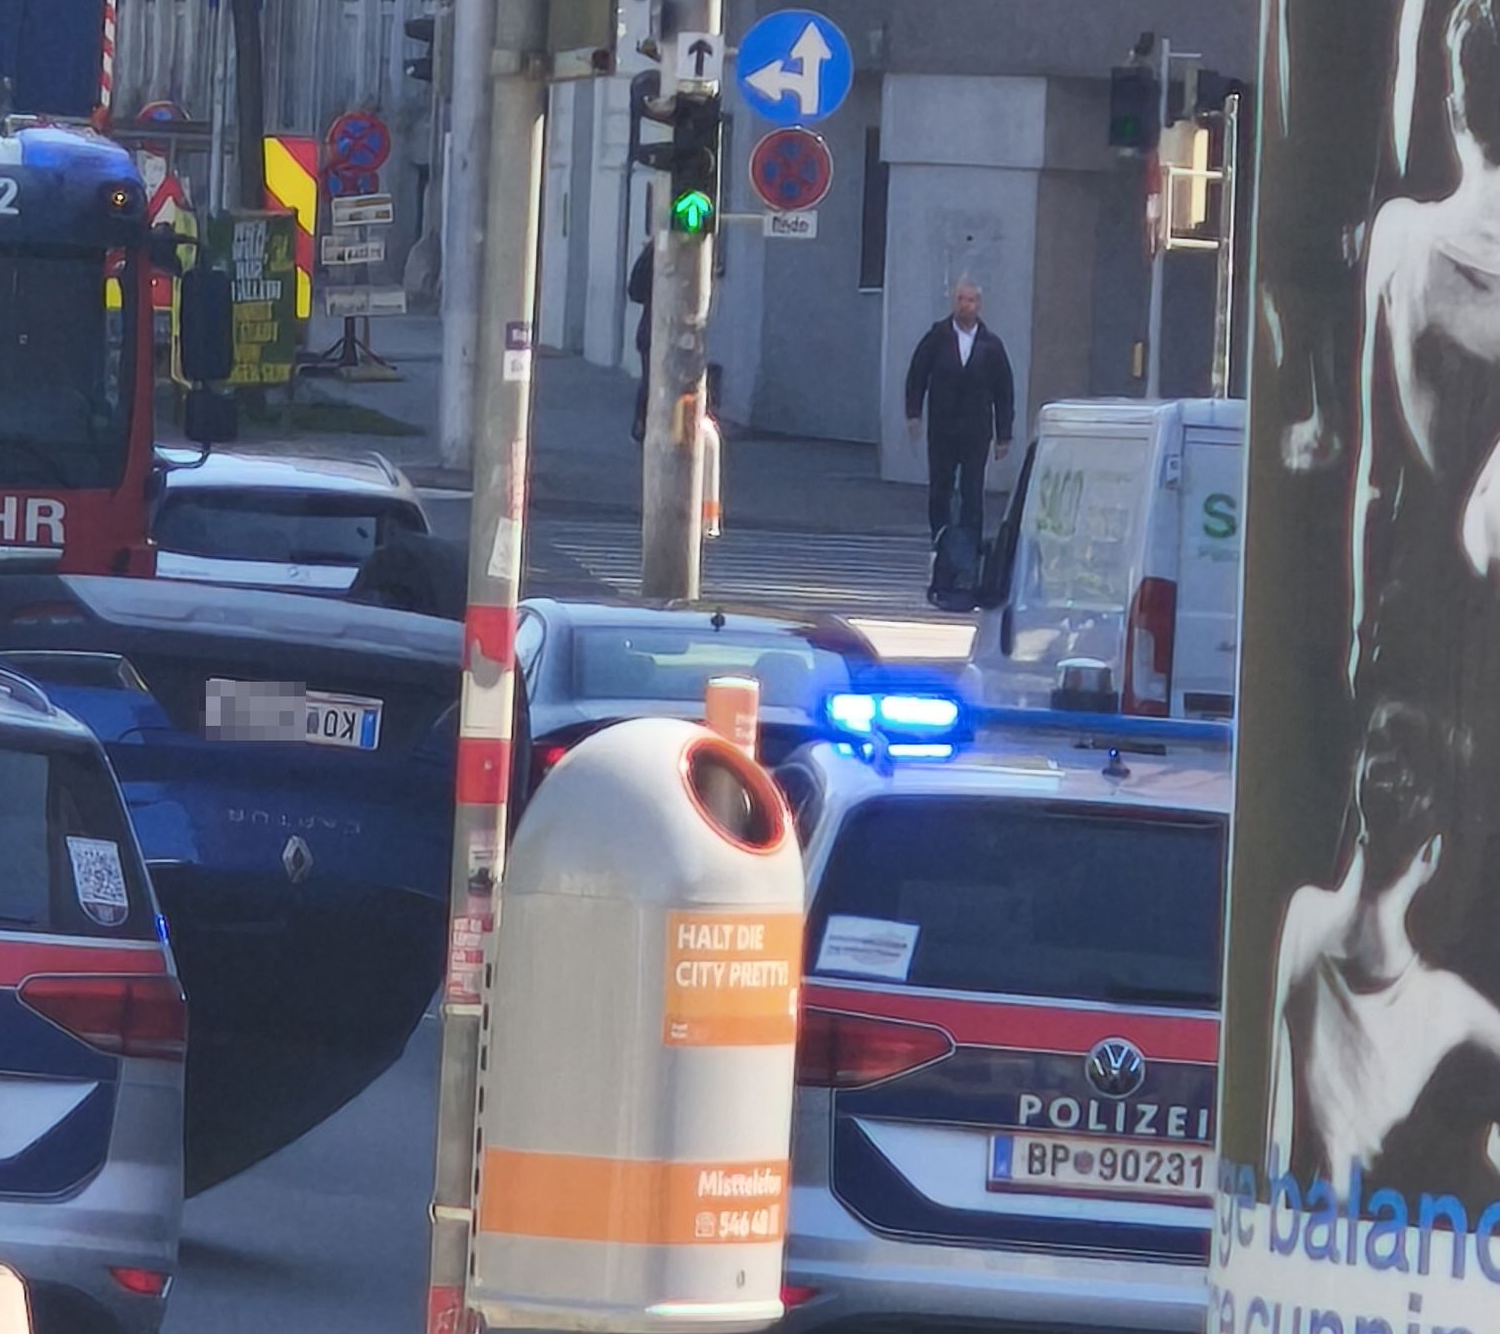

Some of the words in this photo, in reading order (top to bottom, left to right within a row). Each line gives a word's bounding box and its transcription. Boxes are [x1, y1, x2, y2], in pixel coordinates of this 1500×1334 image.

[677, 923, 734, 950] HALT
[736, 923, 766, 951] DIE
[675, 960, 727, 988] CITY
[1017, 1093, 1209, 1140] POLIZEI
[1027, 1141, 1070, 1177] BP
[1098, 1146, 1204, 1190] 90231
